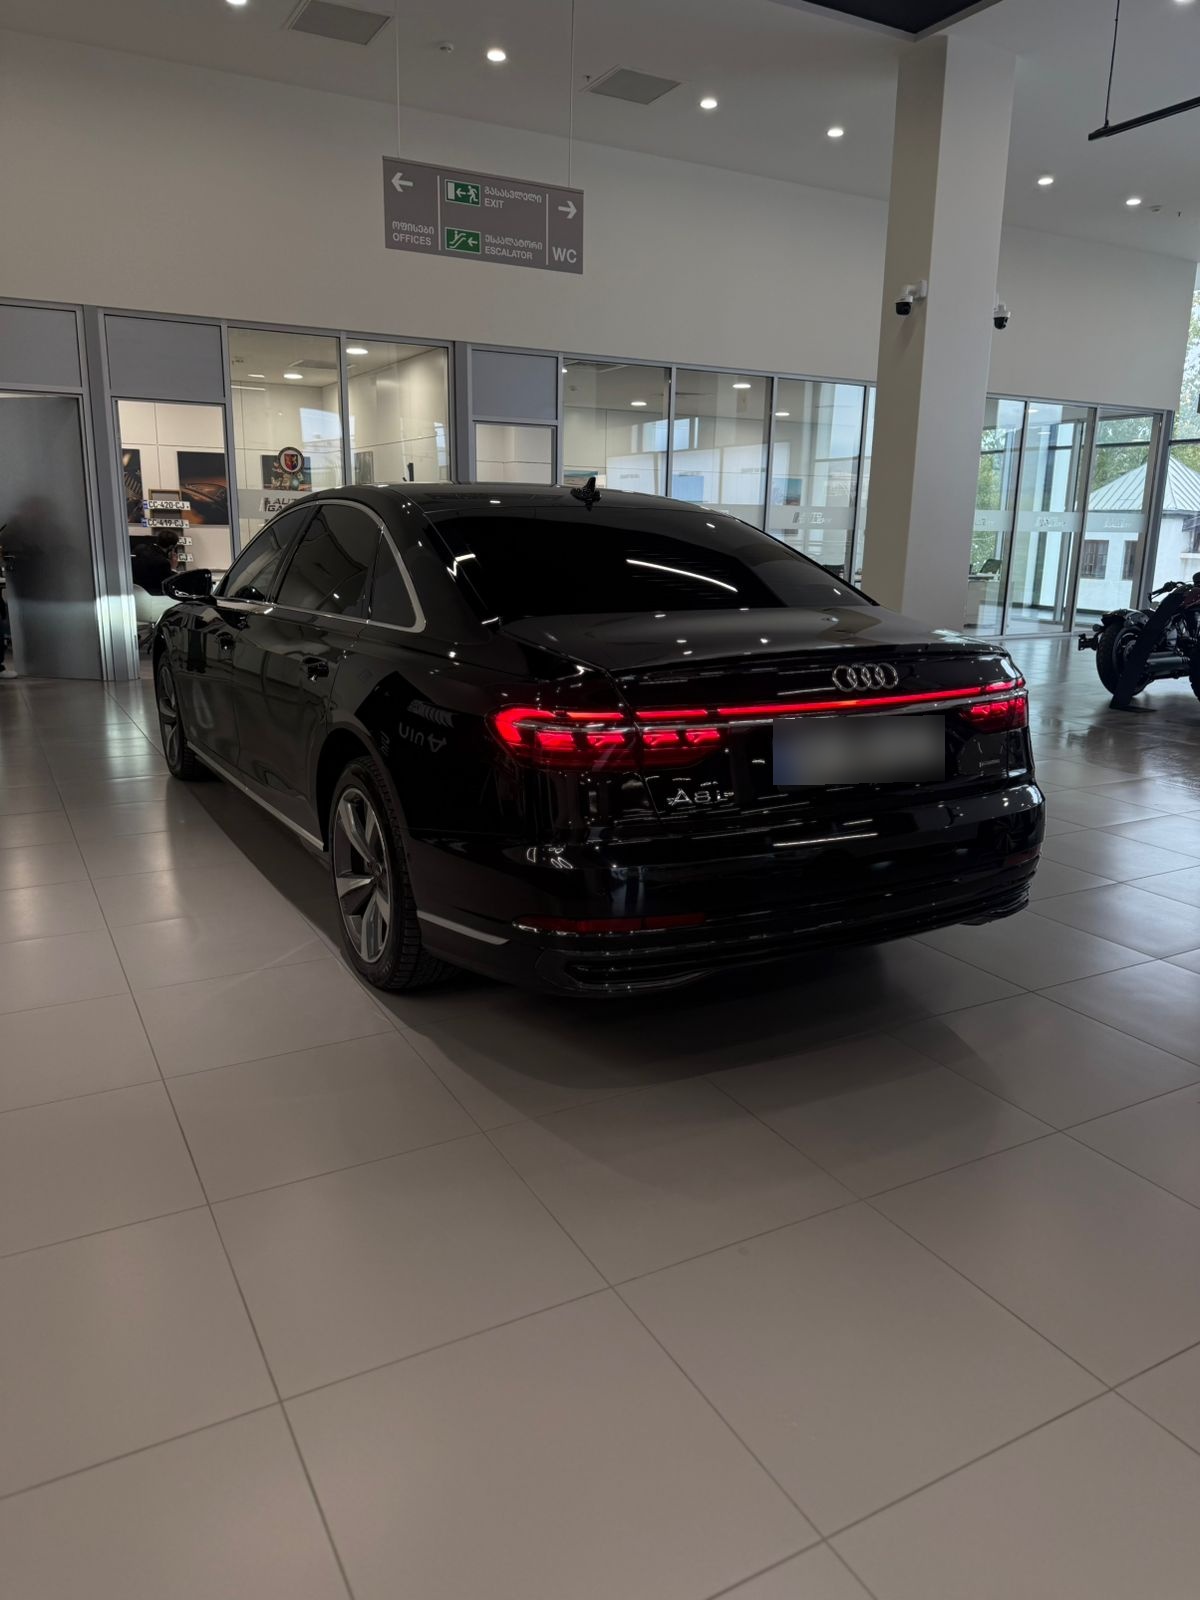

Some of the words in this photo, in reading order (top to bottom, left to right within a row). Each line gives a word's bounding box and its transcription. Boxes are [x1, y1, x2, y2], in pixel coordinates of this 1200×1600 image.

[484, 198, 504, 209] EXIT
[392, 232, 432, 246] OFFICES
[485, 246, 533, 260] ESCALATOR
[552, 246, 577, 264] WC
